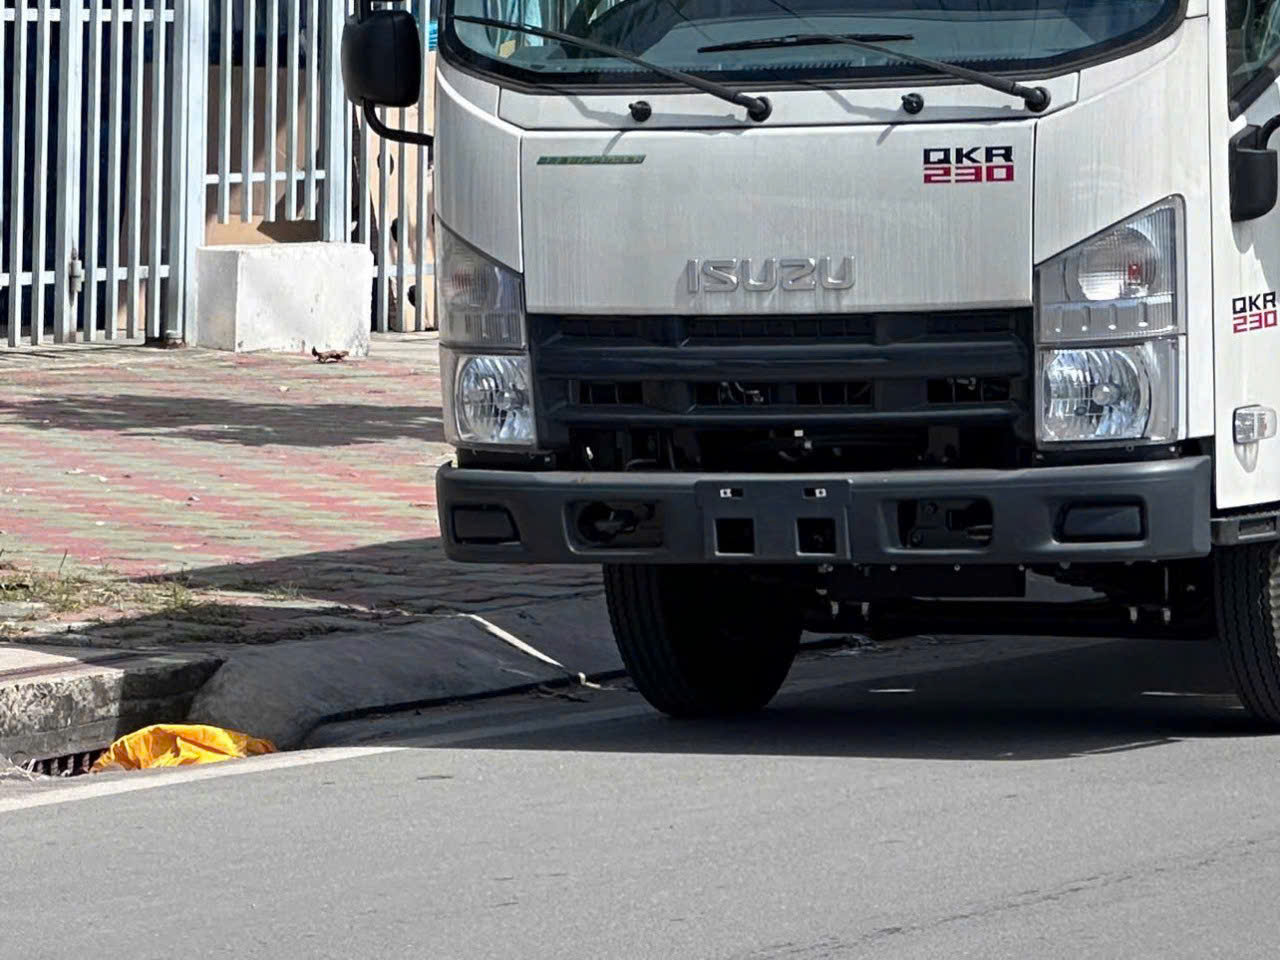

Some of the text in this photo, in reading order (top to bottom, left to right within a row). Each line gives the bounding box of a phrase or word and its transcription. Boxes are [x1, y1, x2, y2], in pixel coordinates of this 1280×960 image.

[923, 146, 1014, 164] QKR
[923, 165, 1014, 184] 230
[687, 256, 856, 293] ISUZU
[1232, 291, 1277, 314] QKR
[1233, 311, 1278, 334] 230
